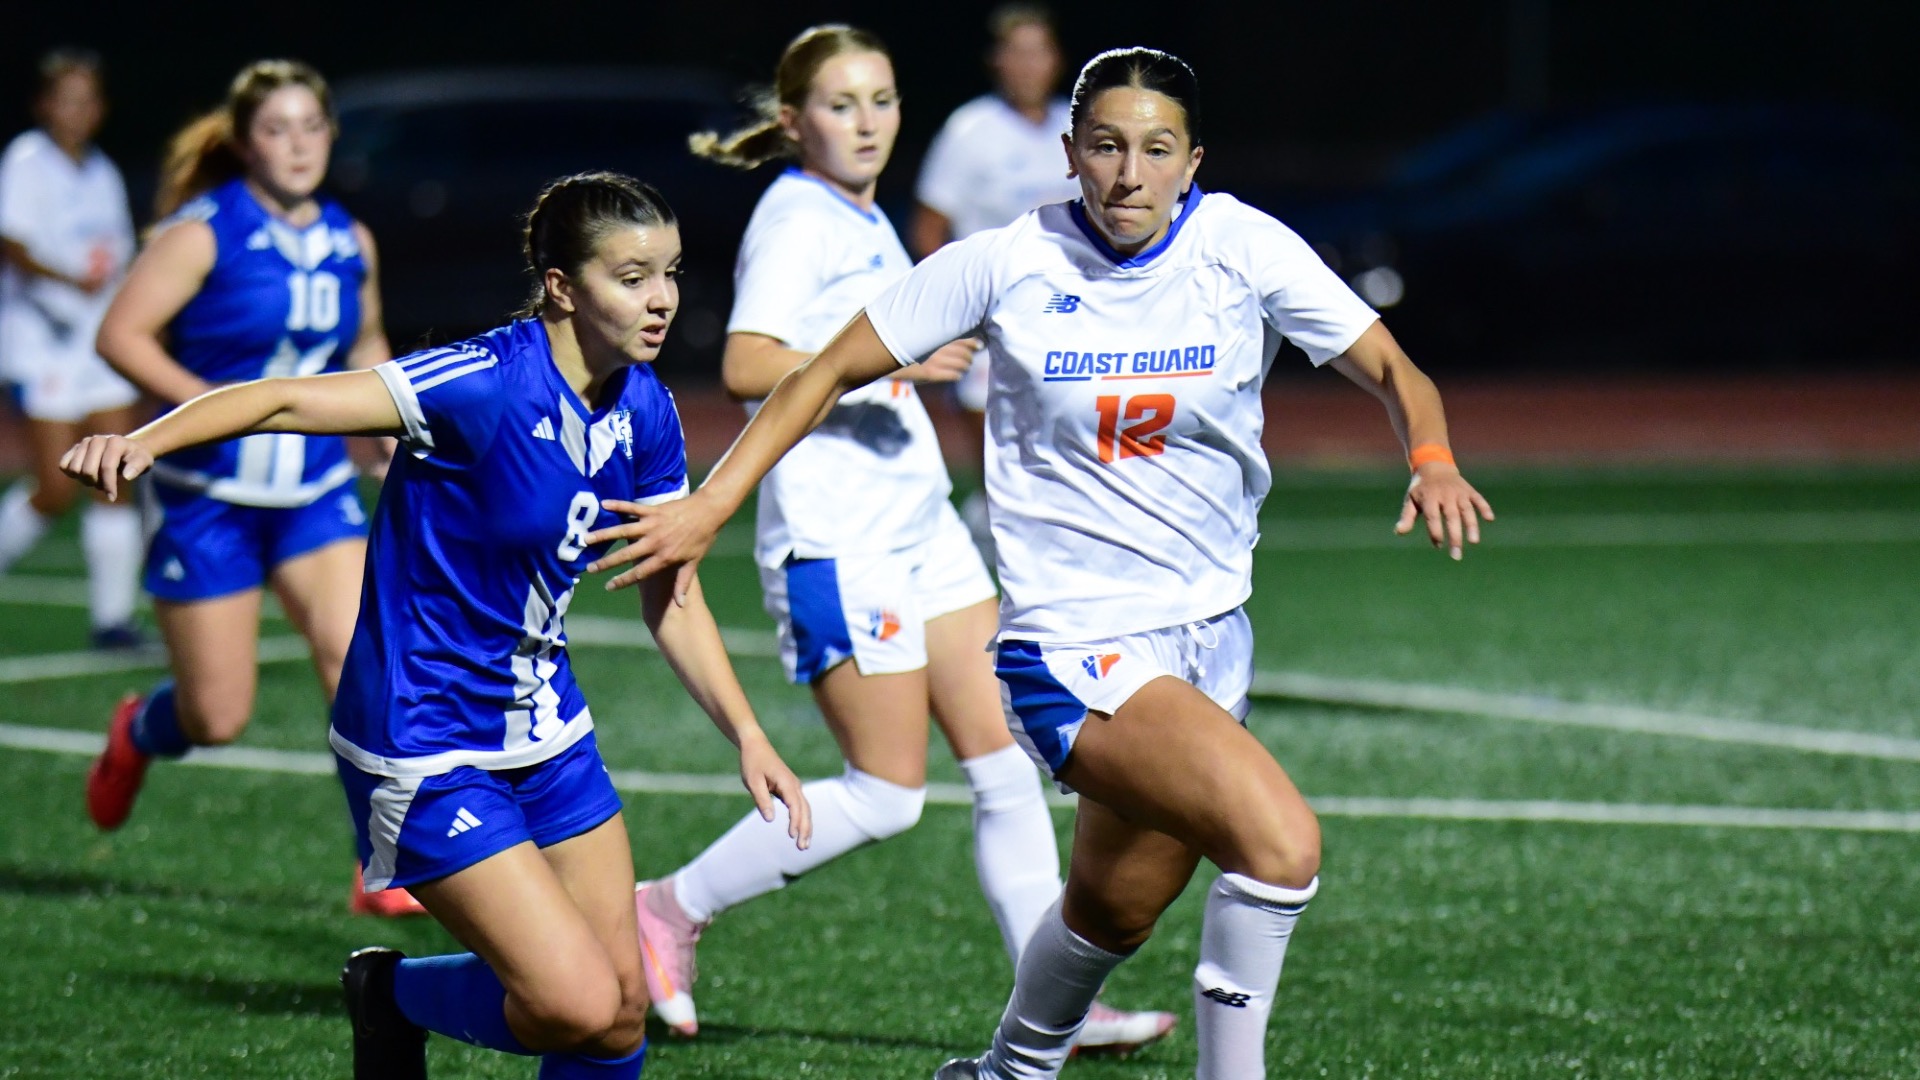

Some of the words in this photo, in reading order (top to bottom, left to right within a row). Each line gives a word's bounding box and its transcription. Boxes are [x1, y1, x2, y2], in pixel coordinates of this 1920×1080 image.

[286, 270, 341, 332] 10
[1044, 351, 1128, 375] COAST
[1132, 344, 1215, 373] GUARD
[1095, 393, 1176, 464] 12
[557, 491, 600, 562] 8
